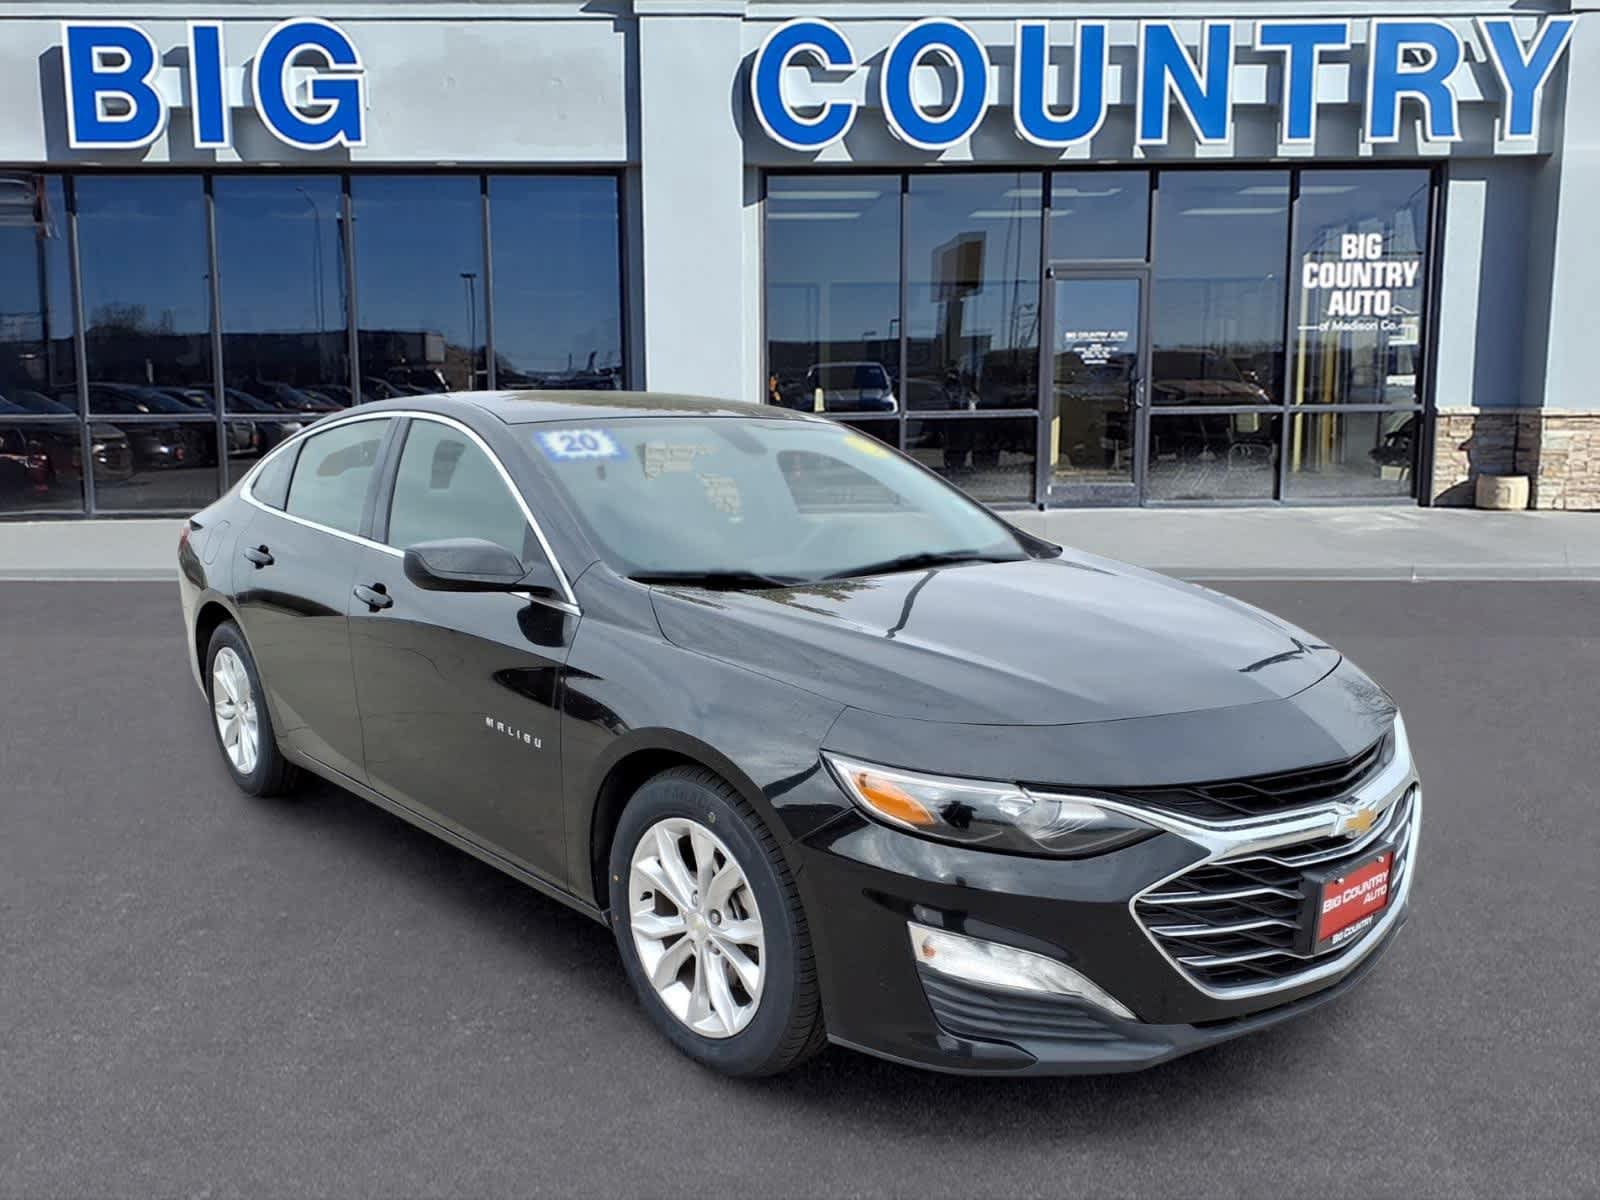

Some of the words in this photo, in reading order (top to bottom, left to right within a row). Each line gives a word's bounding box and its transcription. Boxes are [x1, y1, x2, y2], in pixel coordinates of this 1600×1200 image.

[61, 17, 367, 151] BIG
[751, 15, 1575, 152] COUNTRY
[1341, 233, 1383, 260] BIG
[1303, 261, 1419, 289] COUNTRY
[1328, 290, 1392, 316] AUTO
[559, 434, 600, 452] 20
[485, 717, 542, 748] MALIBU
[1322, 895, 1341, 914] BIG
[1343, 870, 1389, 904] COUNTRY
[1363, 885, 1387, 905] AUTO
[1344, 916, 1373, 936] COUNTRY
